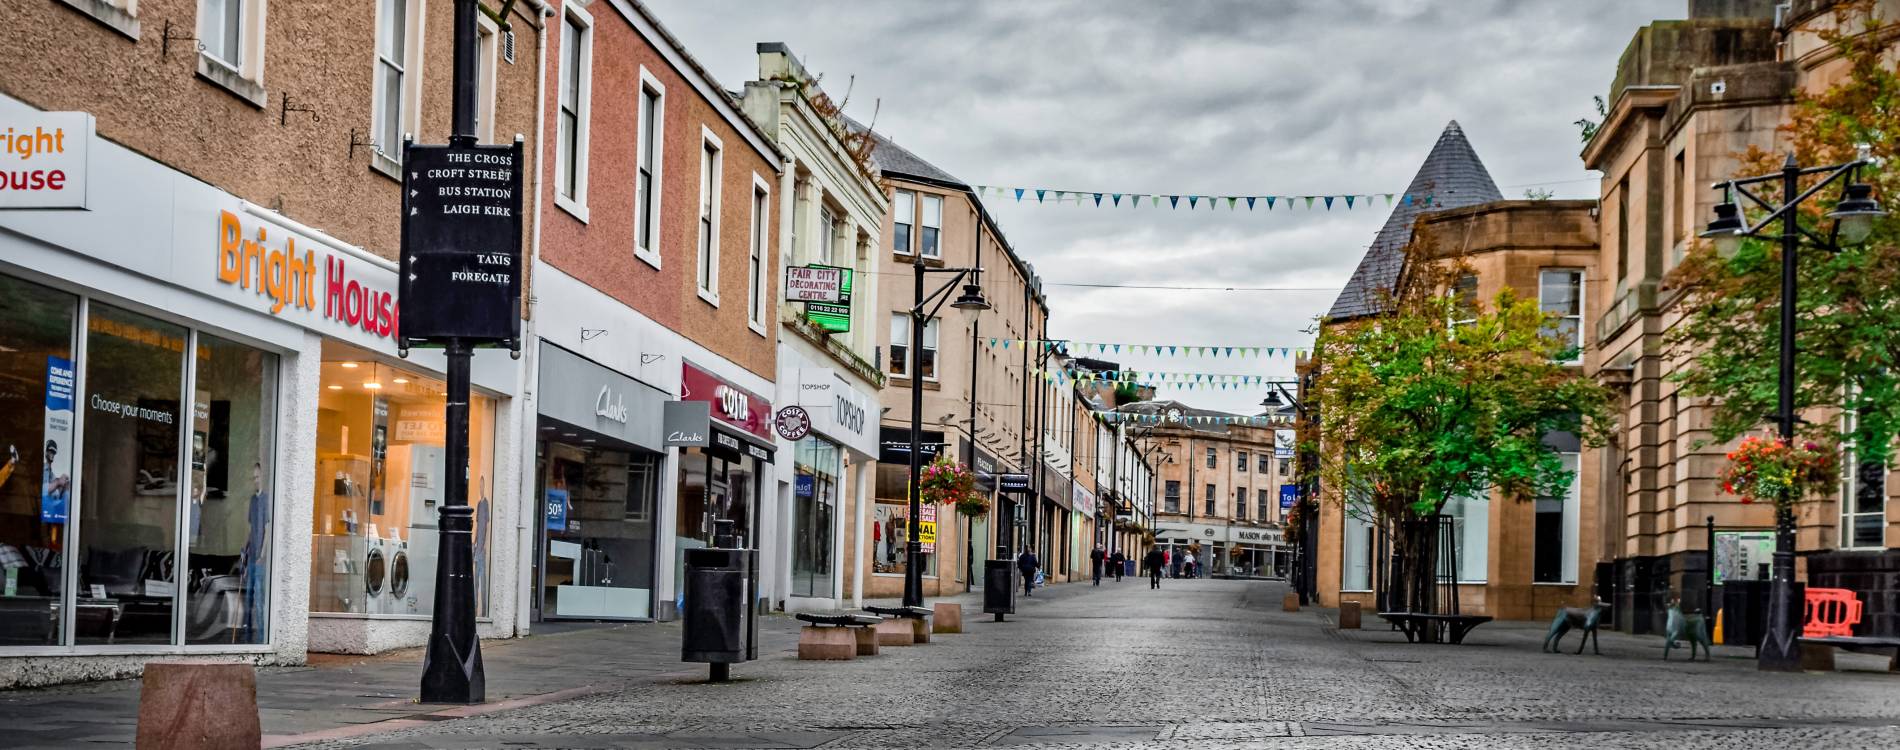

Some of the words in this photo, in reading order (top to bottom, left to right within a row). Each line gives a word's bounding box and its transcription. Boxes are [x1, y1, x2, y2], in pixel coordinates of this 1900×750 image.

[0, 126, 65, 160] ight
[447, 153, 471, 163] THE
[474, 154, 513, 165] CROSS
[0, 169, 66, 191] ouse
[427, 169, 465, 179] CROFT
[468, 169, 512, 182] STREET
[439, 187, 461, 196] BUS
[464, 187, 511, 198] STATION
[444, 205, 480, 215] LAIGH
[484, 206, 511, 217] KIRK
[218, 209, 316, 314] Bright
[477, 255, 511, 266] TAXIS
[452, 271, 510, 283] FOREGATE
[791, 268, 811, 280] FAIR
[817, 270, 837, 281] CITY
[789, 279, 836, 291] DECORATING
[799, 290, 828, 300] CENTRE
[91, 393, 121, 414] Choose
[121, 403, 139, 418] your
[140, 407, 173, 424] moments
[595, 384, 627, 424] Clarks
[721, 385, 748, 421] COSTA
[782, 408, 803, 419] COSTA
[836, 395, 865, 437] TOPSHOP
[667, 431, 703, 442] Clarks
[779, 425, 806, 438] COFFEE
[1282, 493, 1292, 501] To
[548, 503, 563, 515] 50%
[919, 524, 935, 535] NAL
[1238, 531, 1260, 540] MASON
